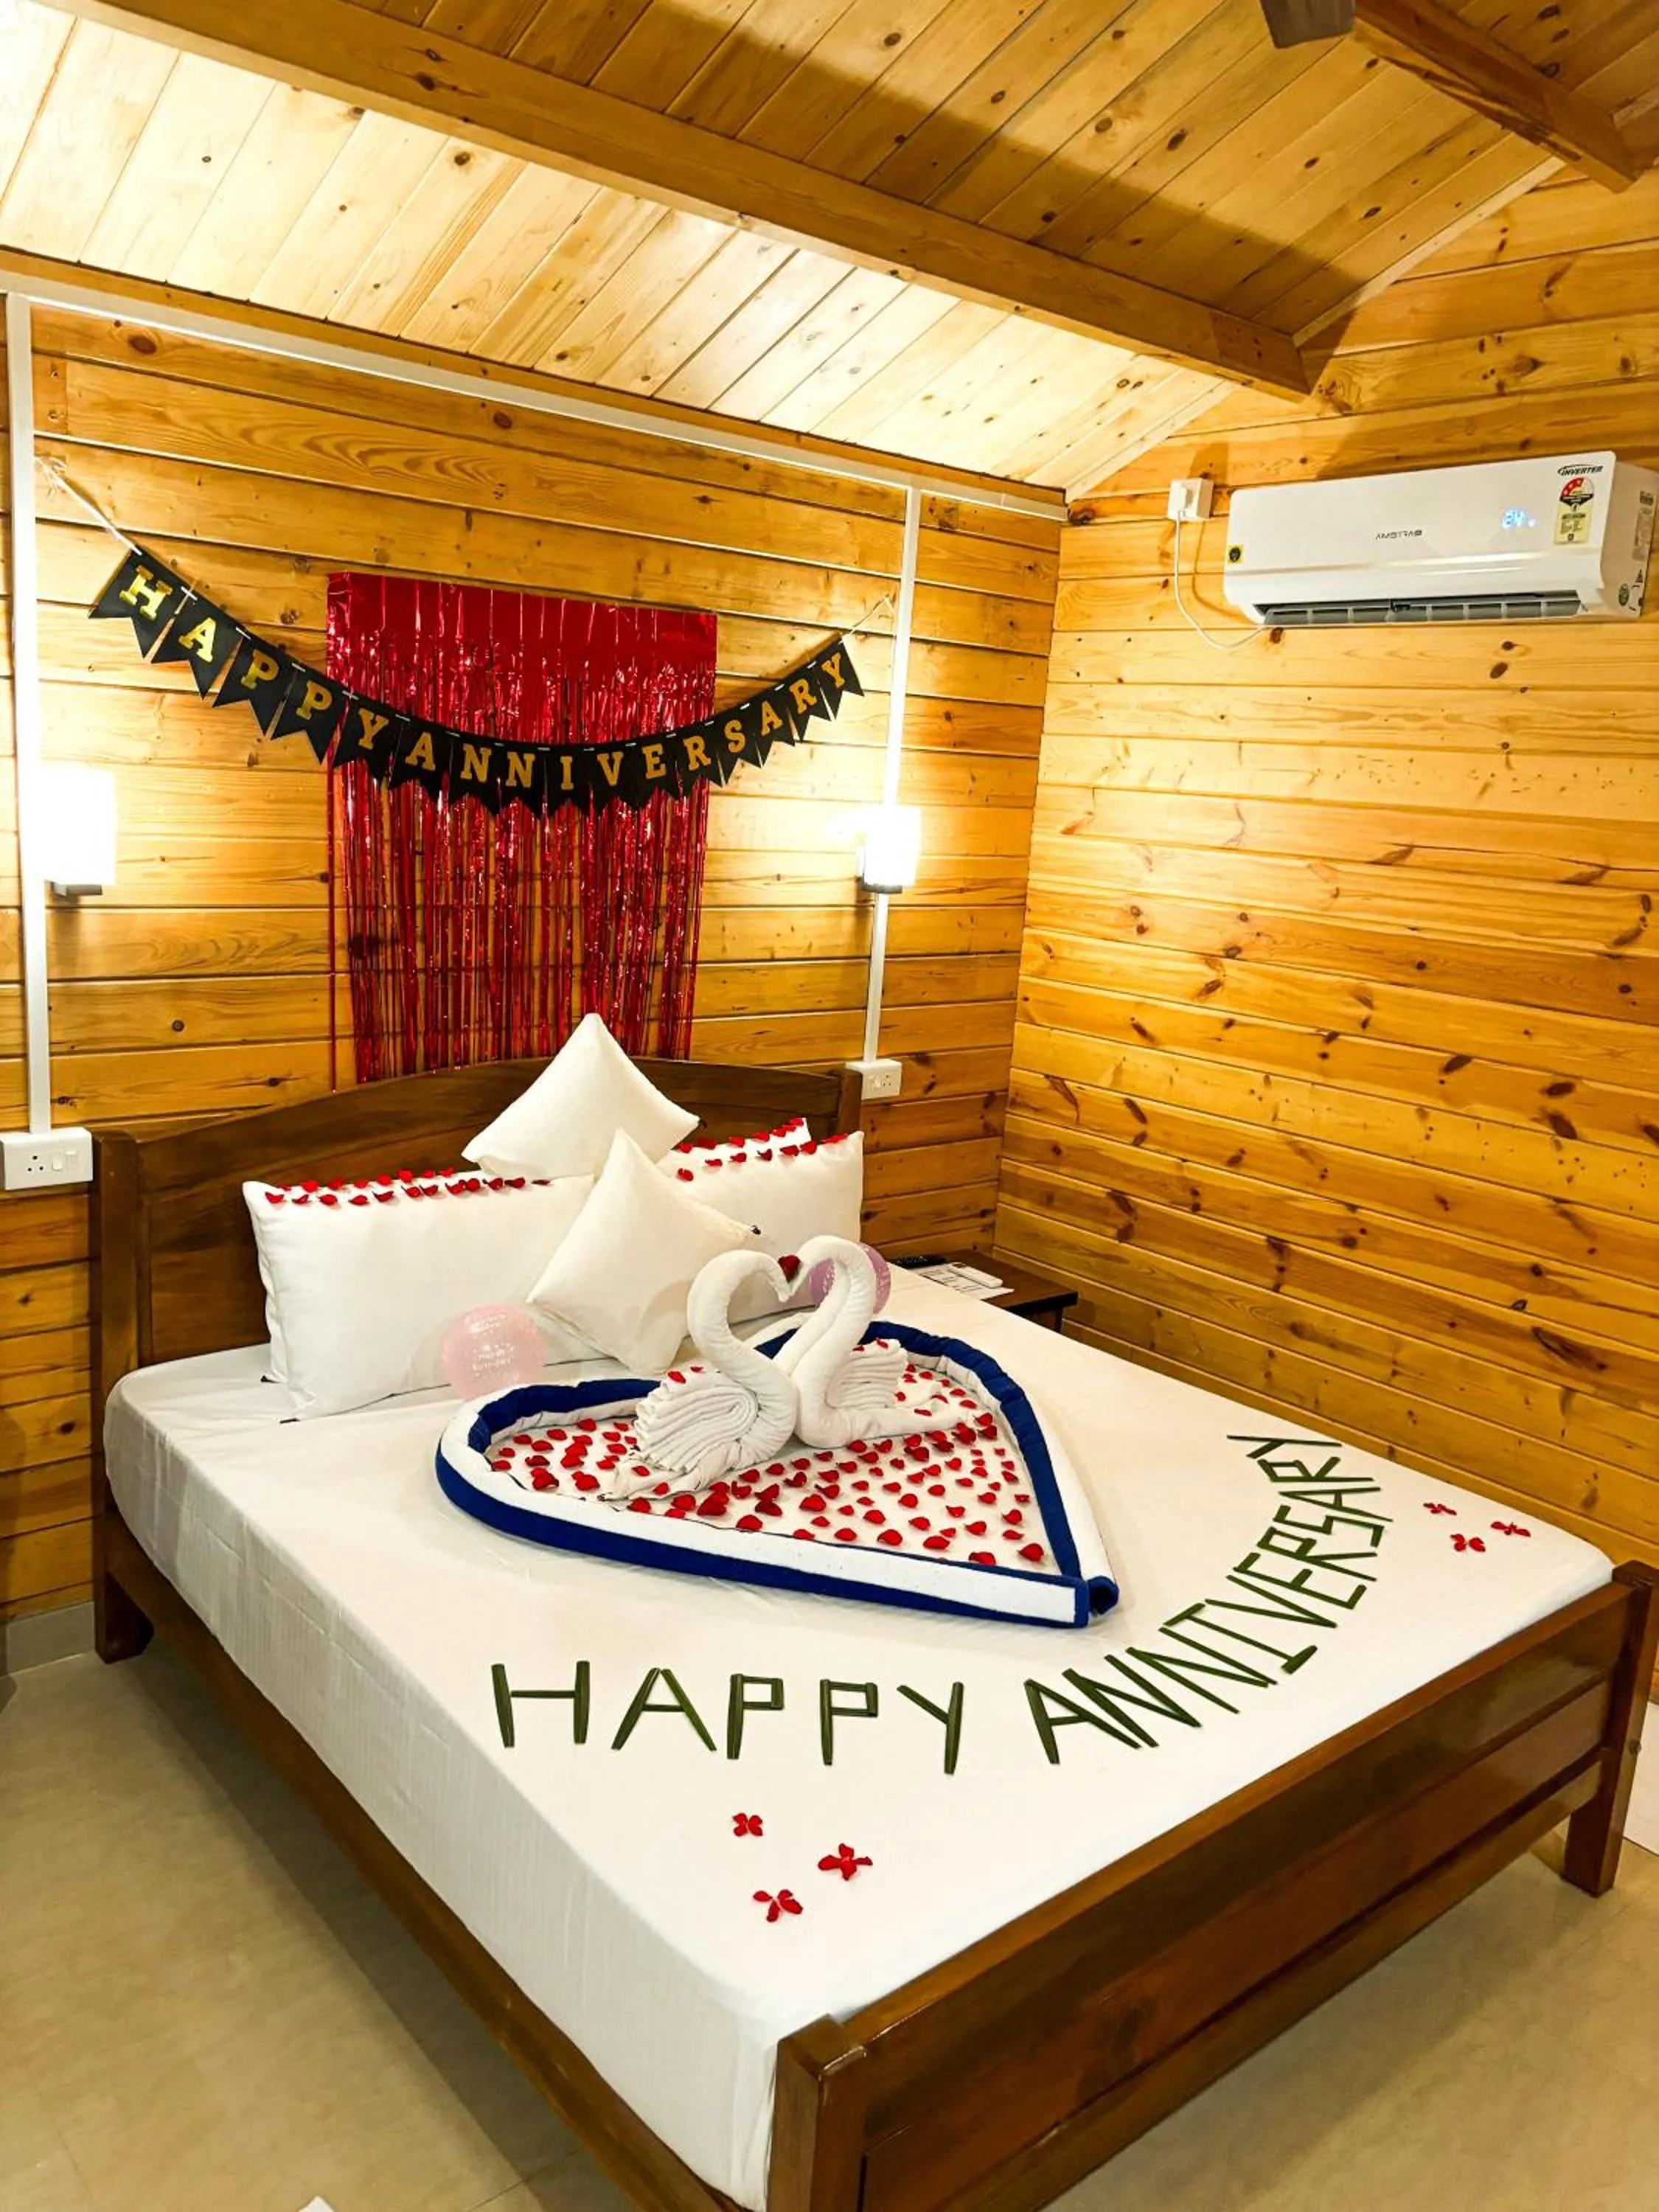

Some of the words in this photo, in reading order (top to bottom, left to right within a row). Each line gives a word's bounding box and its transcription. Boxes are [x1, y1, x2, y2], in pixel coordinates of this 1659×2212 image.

[1558, 464, 1604, 476] INVERTER
[119, 565, 389, 750] HAPPY
[405, 652, 846, 791] ANNIVERSARY
[491, 1660, 964, 1775] HAPPY
[1023, 1435, 1394, 1765] ANNIVERSARY
